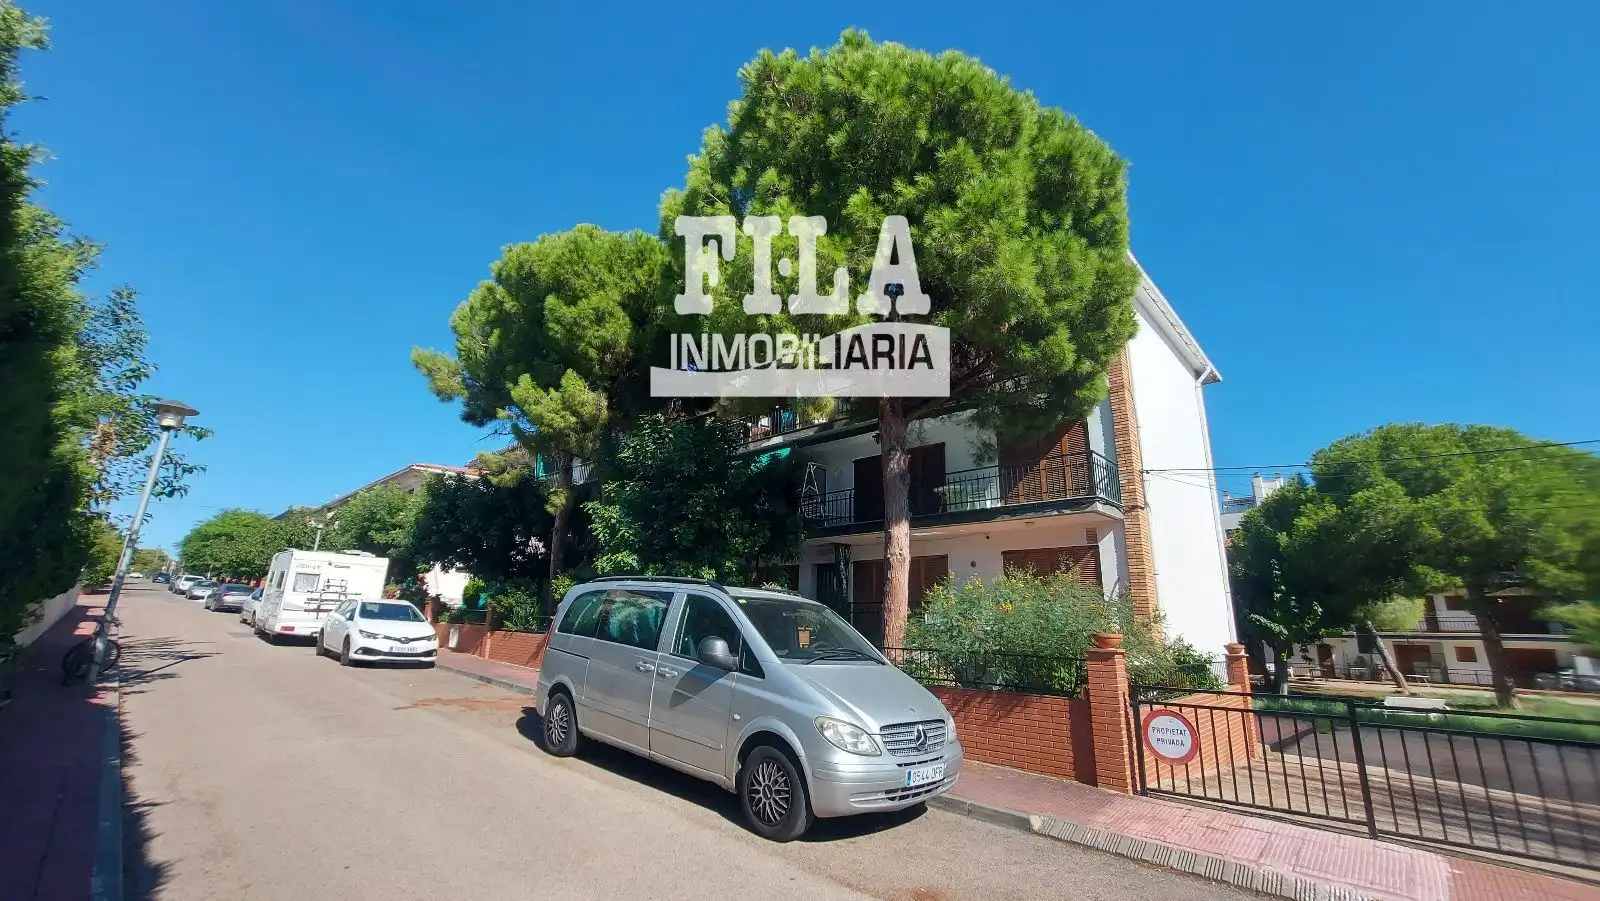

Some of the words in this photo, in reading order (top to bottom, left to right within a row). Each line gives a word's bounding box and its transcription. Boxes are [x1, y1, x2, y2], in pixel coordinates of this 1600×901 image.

[1151, 726, 1186, 736] PROPIETAT
[1156, 737, 1185, 747] PRIVADA
[912, 769, 929, 783] 0544
